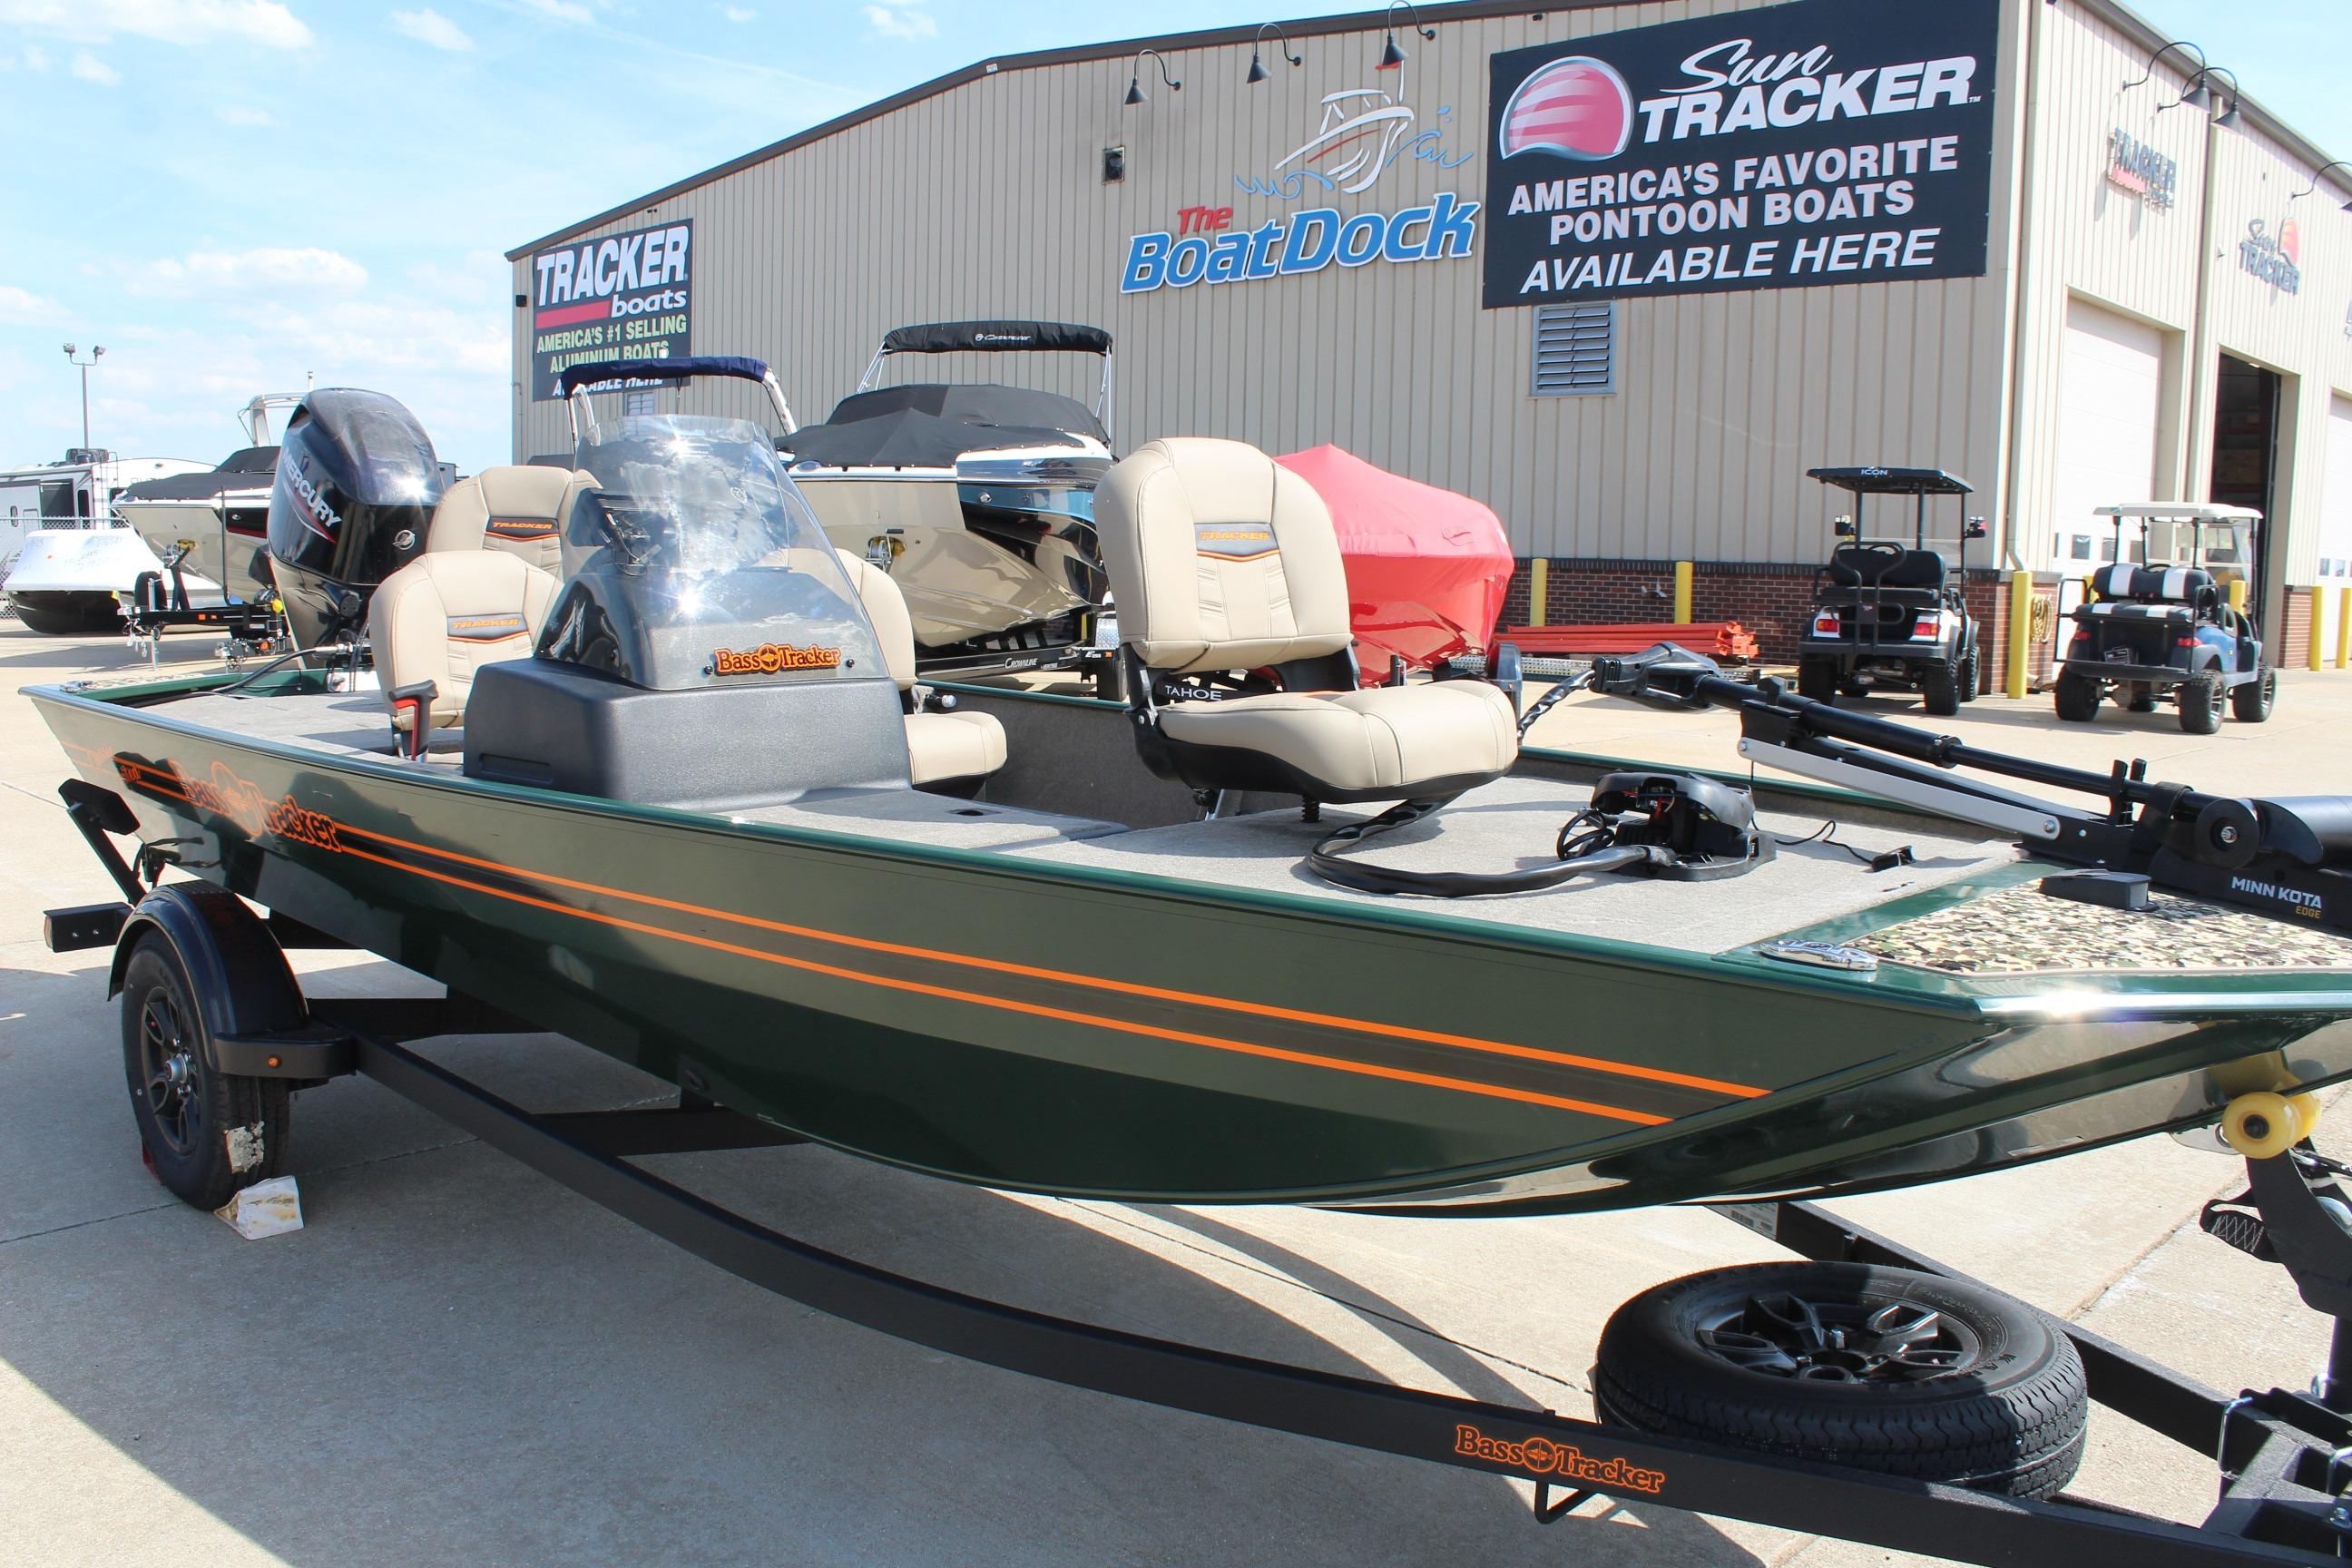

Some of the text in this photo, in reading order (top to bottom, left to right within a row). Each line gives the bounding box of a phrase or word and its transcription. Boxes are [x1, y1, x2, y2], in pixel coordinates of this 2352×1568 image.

[1660, 38, 1833, 93] Sun
[1639, 55, 1976, 143] TRACKER
[1507, 135, 1959, 217] AMERICA'S FAVORITE
[1177, 205, 1233, 234] The
[1549, 181, 1914, 246] PONTOON BOATS
[537, 225, 690, 307] TRACKER
[1519, 227, 1941, 294] AVAILABLE HERE
[2239, 241, 2300, 296] TRACKER
[611, 289, 688, 318] boats
[536, 314, 687, 354] AMERICA'S #1 SELLING
[282, 447, 342, 527] MERCURY
[1861, 468, 1888, 476] ICON
[492, 521, 554, 530] TRACKER
[1200, 529, 1270, 542] TRACKER
[453, 618, 519, 629] TRACKER
[715, 644, 841, 673] Bass Tracker
[1164, 685, 1222, 701] TAHOE
[2231, 876, 2323, 909] MINN KOTA
[2295, 905, 2322, 919] EDGE
[1455, 1425, 1666, 1494] Bass Tracker
